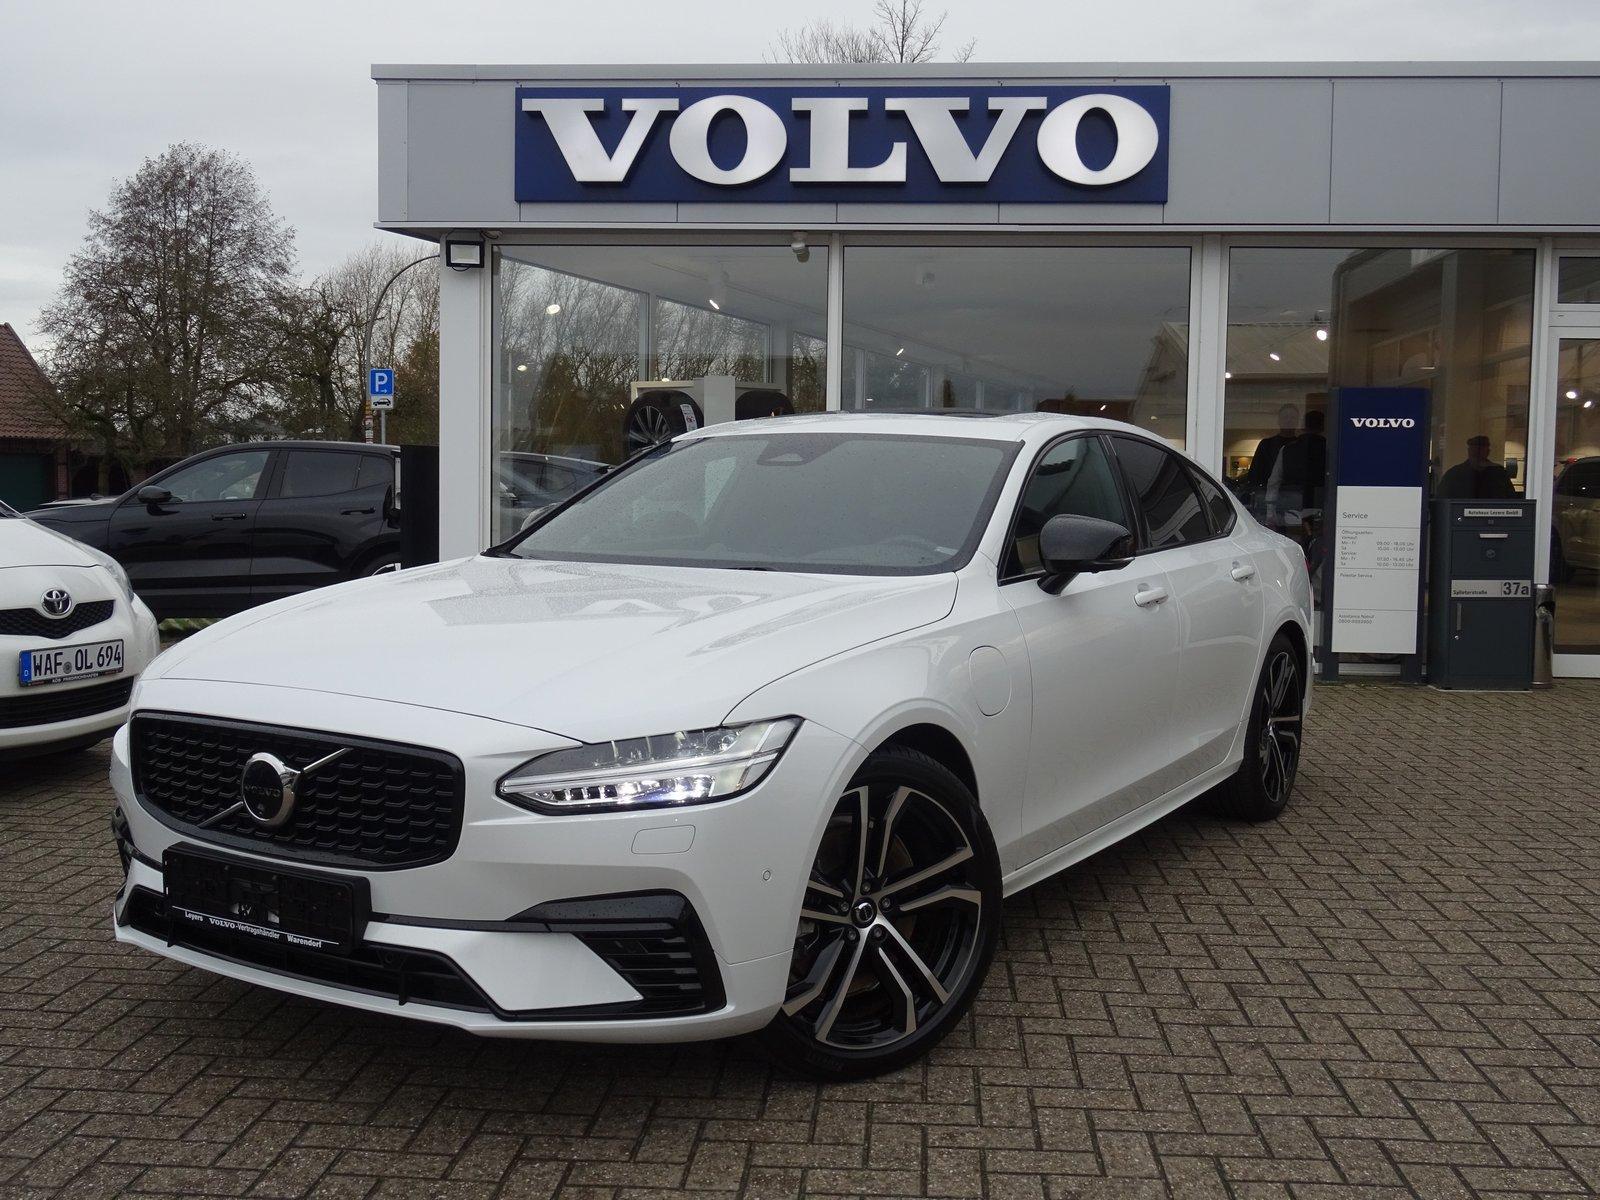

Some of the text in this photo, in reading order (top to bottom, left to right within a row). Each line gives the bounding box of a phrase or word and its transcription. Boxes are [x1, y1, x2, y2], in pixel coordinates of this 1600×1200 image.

[521, 93, 1160, 186] VOLVO
[375, 372, 388, 392] P
[1350, 417, 1415, 428] VOLVO
[1503, 582, 1529, 596] 37a
[33, 652, 64, 676] WAF
[75, 649, 93, 671] OL
[97, 645, 121, 667] 694
[184, 910, 204, 922] Leyers
[286, 934, 322, 948] Warendorf
